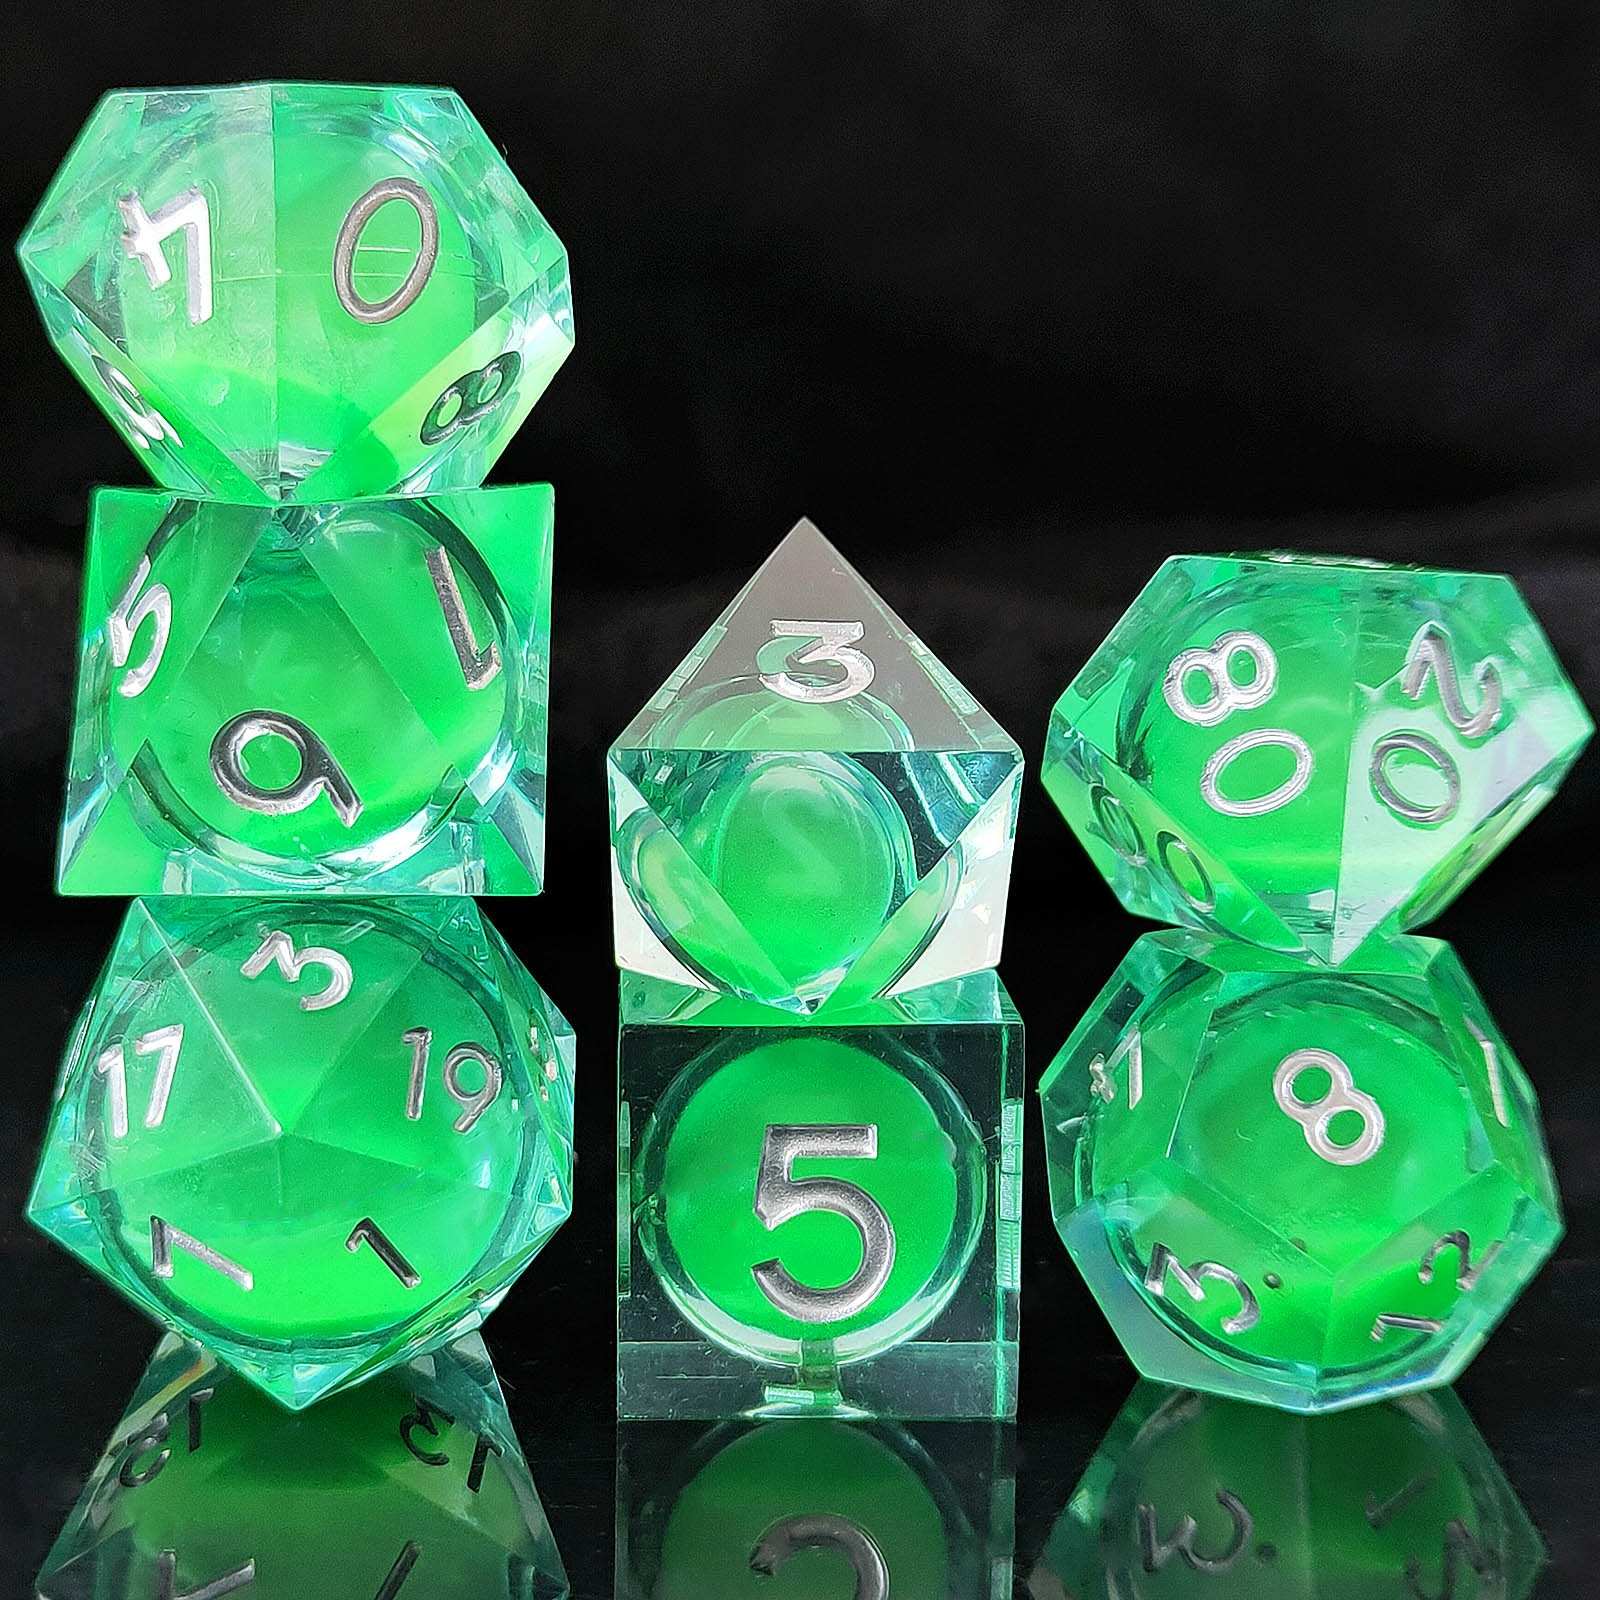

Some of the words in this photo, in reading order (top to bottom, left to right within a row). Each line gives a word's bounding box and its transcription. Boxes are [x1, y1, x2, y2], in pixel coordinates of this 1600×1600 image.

[117, 184, 214, 326] 4
[334, 177, 440, 325] 0
[420, 351, 522, 445] 8
[107, 553, 173, 699] 5
[756, 620, 876, 702] 3
[97, 1023, 184, 1138] 17
[403, 1027, 502, 1134] 19
[1272, 1047, 1387, 1166] 8
[345, 1217, 422, 1289] 1
[750, 1123, 896, 1323] 5
